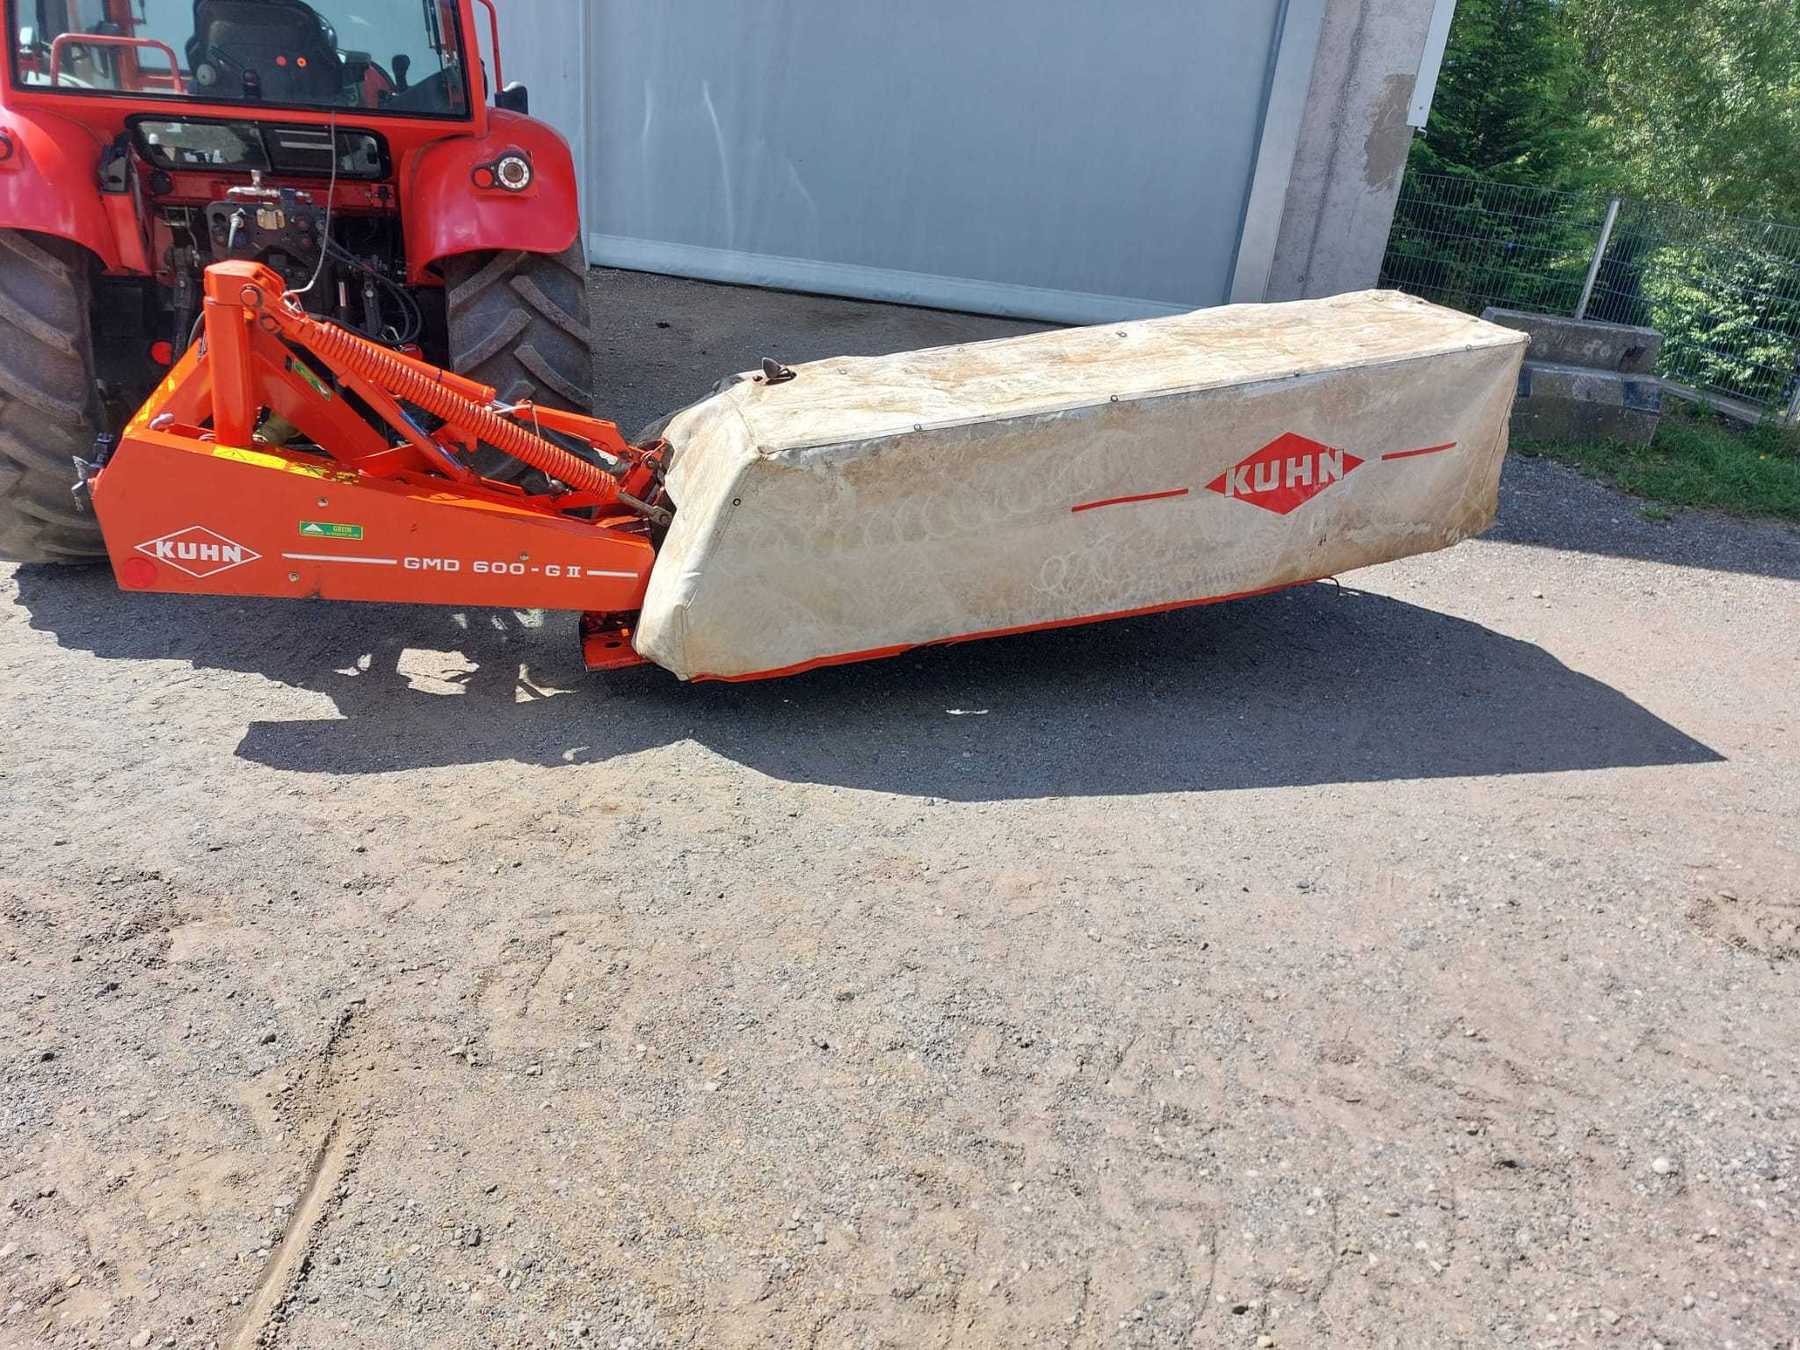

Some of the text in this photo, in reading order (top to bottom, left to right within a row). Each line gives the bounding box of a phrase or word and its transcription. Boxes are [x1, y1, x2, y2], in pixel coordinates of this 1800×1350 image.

[1224, 448, 1345, 498] KUHN
[156, 541, 241, 563] KUHN
[404, 557, 460, 571] GMD
